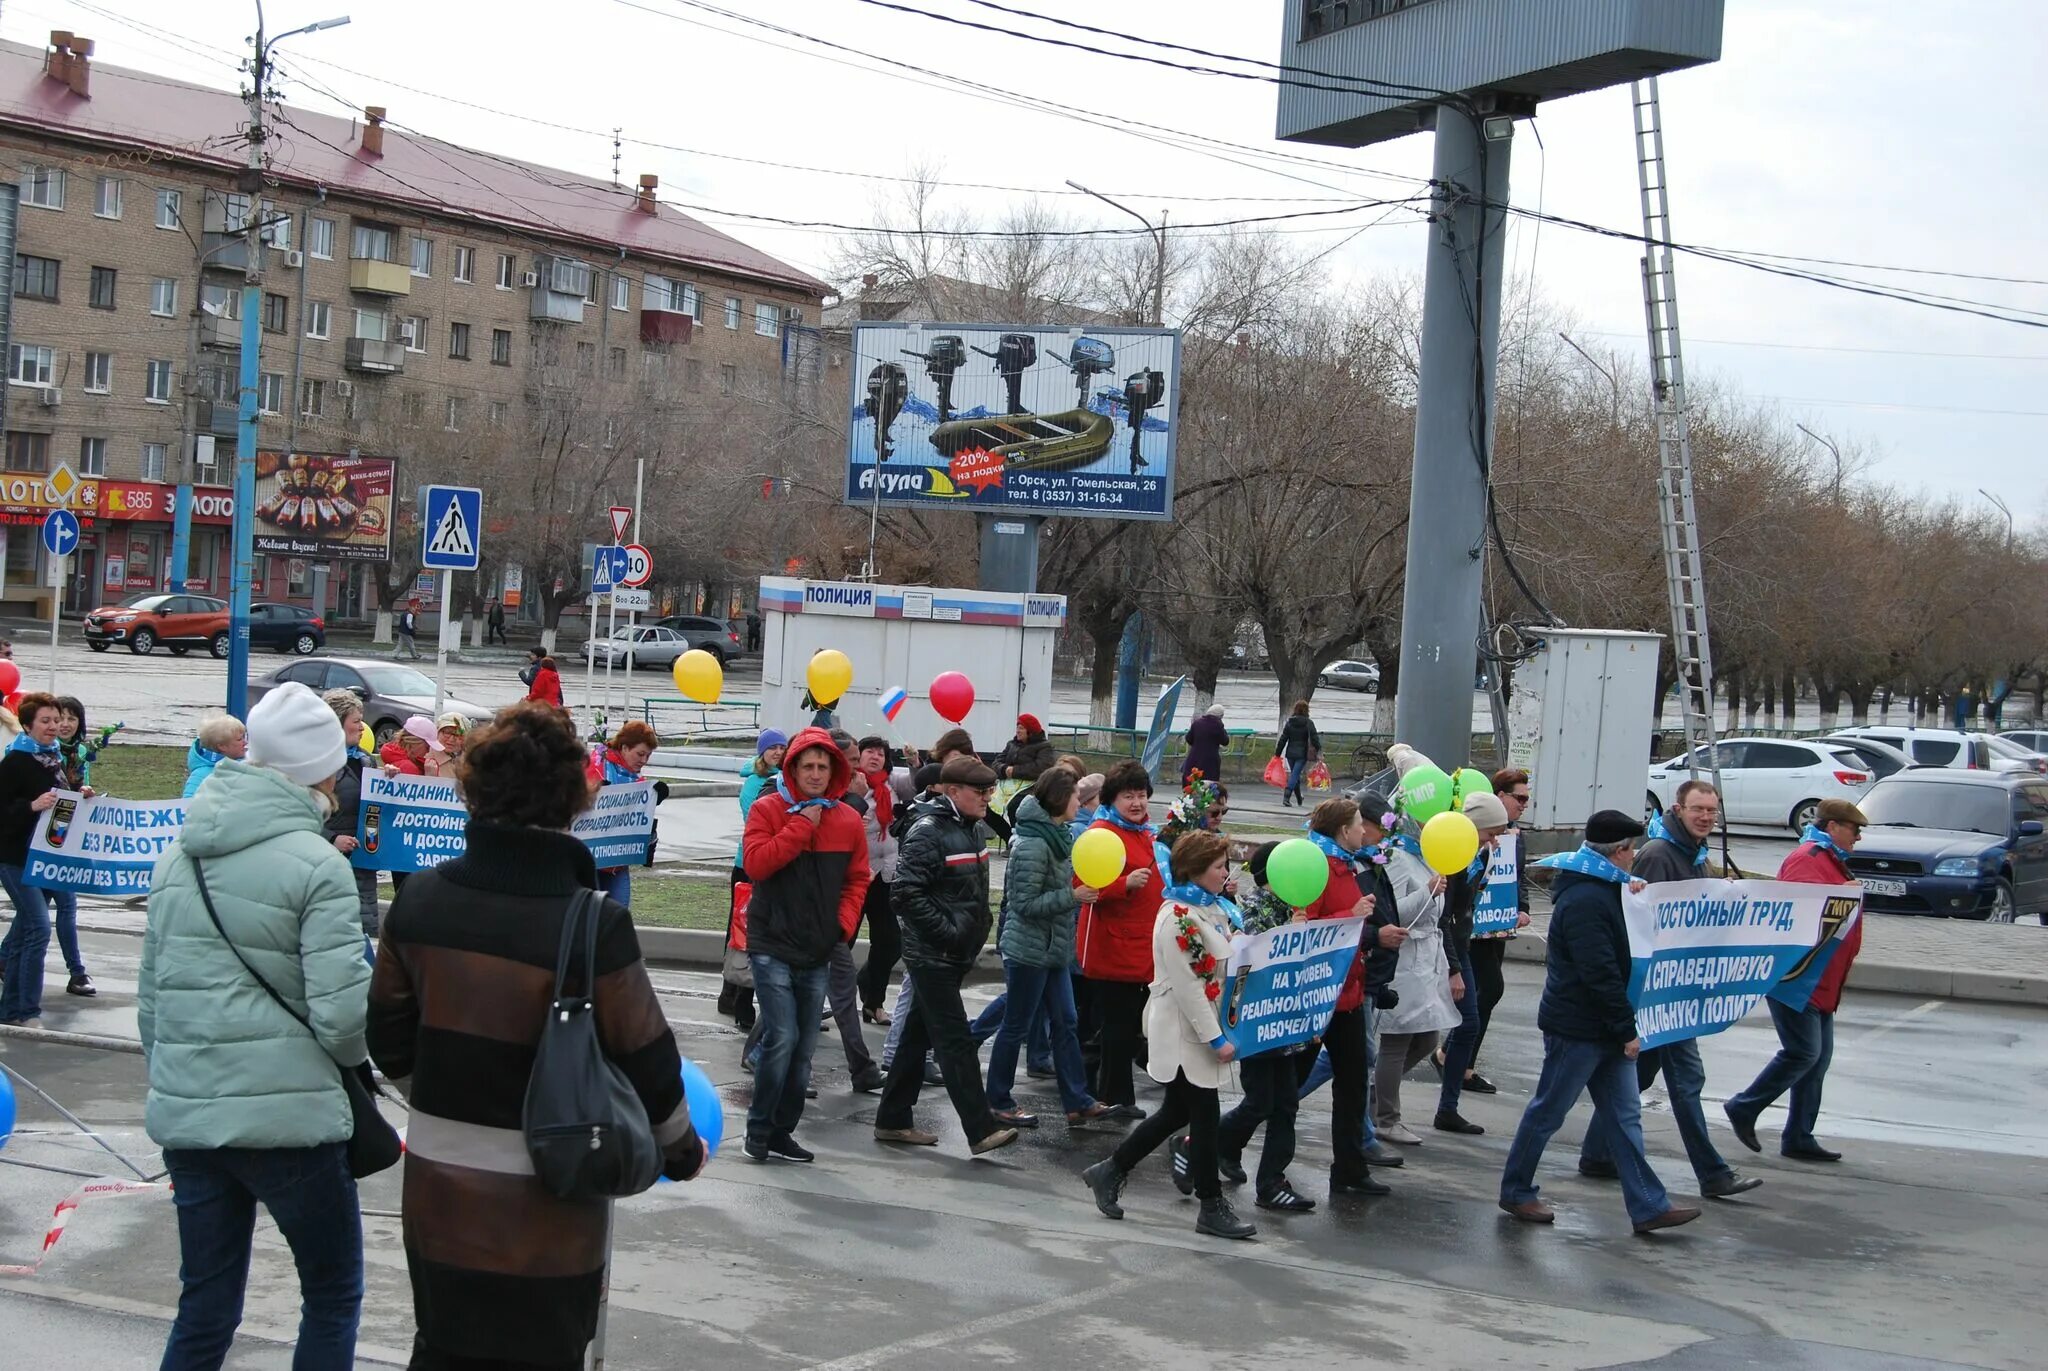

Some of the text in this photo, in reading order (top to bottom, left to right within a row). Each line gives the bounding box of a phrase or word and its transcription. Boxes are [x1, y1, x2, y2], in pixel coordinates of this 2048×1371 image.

[956, 450, 989, 467] -20%
[859, 468, 923, 493] Акула
[973, 464, 1005, 478] лодки
[1008, 474, 1157, 491] г. Орск, ул. Гомельская, 26
[126, 490, 153, 509] 585
[163, 493, 235, 517] ЗЛОТО
[1008, 489, 1123, 503] тел. 8 (3537) 31-16-34
[806, 586, 872, 607] ПОЛИЦИЯ
[1027, 600, 1060, 619] ПОЛИЦИЯ
[370, 778, 459, 804] ГРАЖДАНИН
[597, 790, 649, 810] СОЦИАЛЬНУЮ
[573, 812, 649, 832] СПРАВЕДЛИВОСТЬ
[81, 832, 174, 855] БЕЗ РАБОТ
[594, 843, 645, 858] ОТНОШЕНИЯХ!
[416, 853, 456, 868] ЗАР
[31, 861, 93, 885] РОССИЯ
[93, 869, 112, 887] БЕЗ
[1749, 901, 1794, 931] ТРУД,
[1824, 899, 1858, 916] ГМП
[1272, 961, 1333, 989] НА УРОВЕНЬ
[1653, 954, 1775, 991] СПРАВЕДЛИВУЮ
[1241, 993, 1301, 1022] РЕАЛЬНОЙ
[1258, 1013, 1309, 1042] РАБОЧЕЙ
